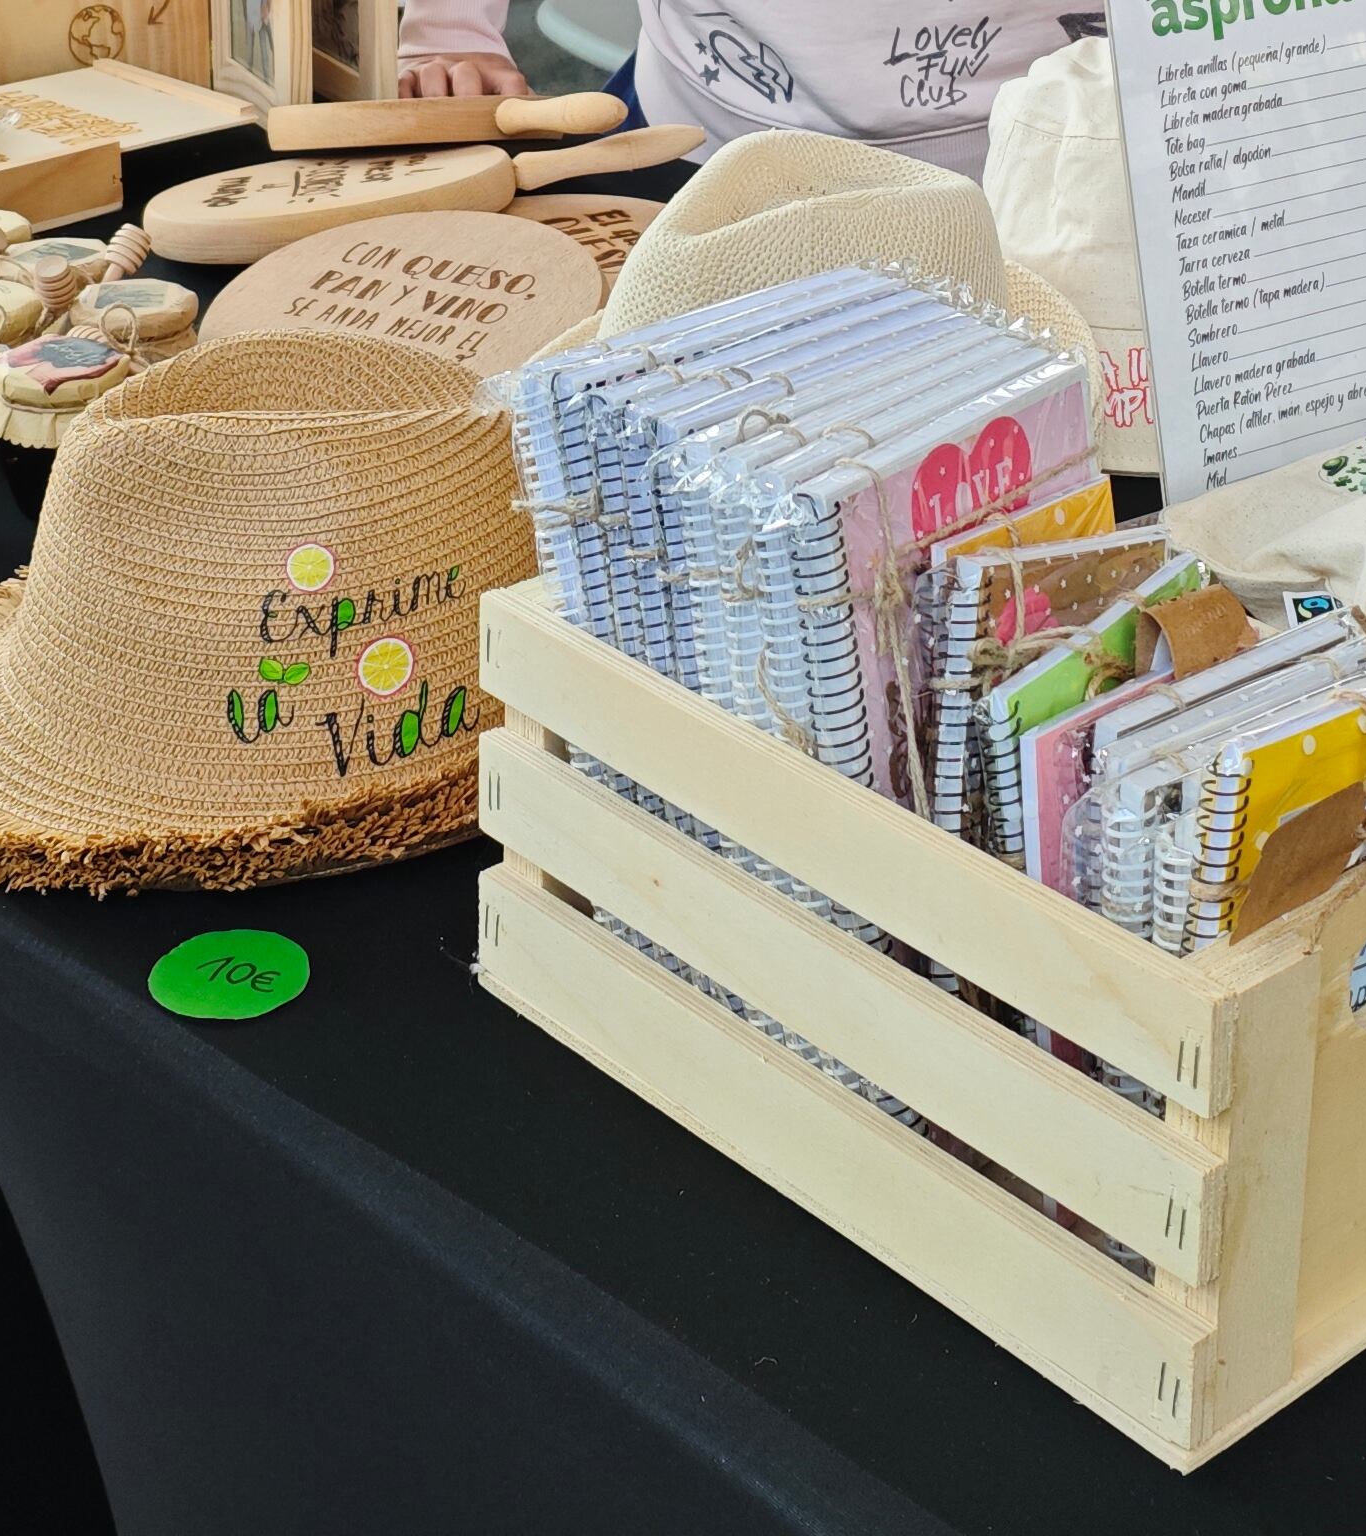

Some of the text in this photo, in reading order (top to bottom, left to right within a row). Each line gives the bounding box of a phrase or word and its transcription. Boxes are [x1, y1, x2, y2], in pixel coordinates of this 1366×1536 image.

[884, 16, 1003, 66] Lovely
[917, 53, 990, 81] FUN
[1157, 64, 1194, 85] Libreta
[1197, 56, 1228, 75] anillas
[900, 75, 967, 109] Club
[1160, 87, 1197, 109] Libreta
[1200, 84, 1218, 100] con
[1221, 80, 1247, 101] goma
[1163, 112, 1200, 133] Libreta
[1165, 136, 1184, 156] Tote
[1186, 133, 1206, 153] bag
[1169, 161, 1196, 182] Bolsa
[1233, 143, 1271, 167] algodón
[1172, 180, 1206, 203] Mandil
[1174, 206, 1212, 228] Neceser
[1176, 233, 1199, 252] Taza
[1202, 224, 1247, 246] cerámica
[1261, 210, 1285, 231] metal
[342, 240, 539, 300] CON QUESO,
[1179, 254, 1208, 276] Jarra
[1212, 247, 1250, 268] cerveza
[310, 270, 510, 325] PAN Y VINO
[1182, 279, 1216, 301] Botella
[1219, 272, 1247, 291] termo
[1185, 300, 1219, 325] Botella
[1221, 295, 1250, 314] termo
[1253, 286, 1280, 312] (tapa
[1283, 272, 1325, 299] madera)
[284, 295, 488, 354] SE ANDA MEJOR EL
[1188, 323, 1238, 348] Sombrero
[1191, 350, 1229, 372] Llavero
[1194, 372, 1232, 396] Llavero
[1235, 364, 1273, 389] madera
[1275, 348, 1316, 378] grabada
[1196, 396, 1230, 420] Puerta
[1234, 389, 1262, 410] Ratón
[1265, 380, 1293, 402] Pérez
[1199, 420, 1236, 444] Chapas
[1305, 391, 1335, 417] espejo
[1338, 394, 1345, 412] y
[1203, 446, 1238, 467] Imanes
[935, 457, 1029, 534] LOVE
[1206, 468, 1227, 491] Miel
[259, 564, 466, 657] Exprime
[227, 680, 479, 778] la Vida
[197, 956, 281, 994] 10€
